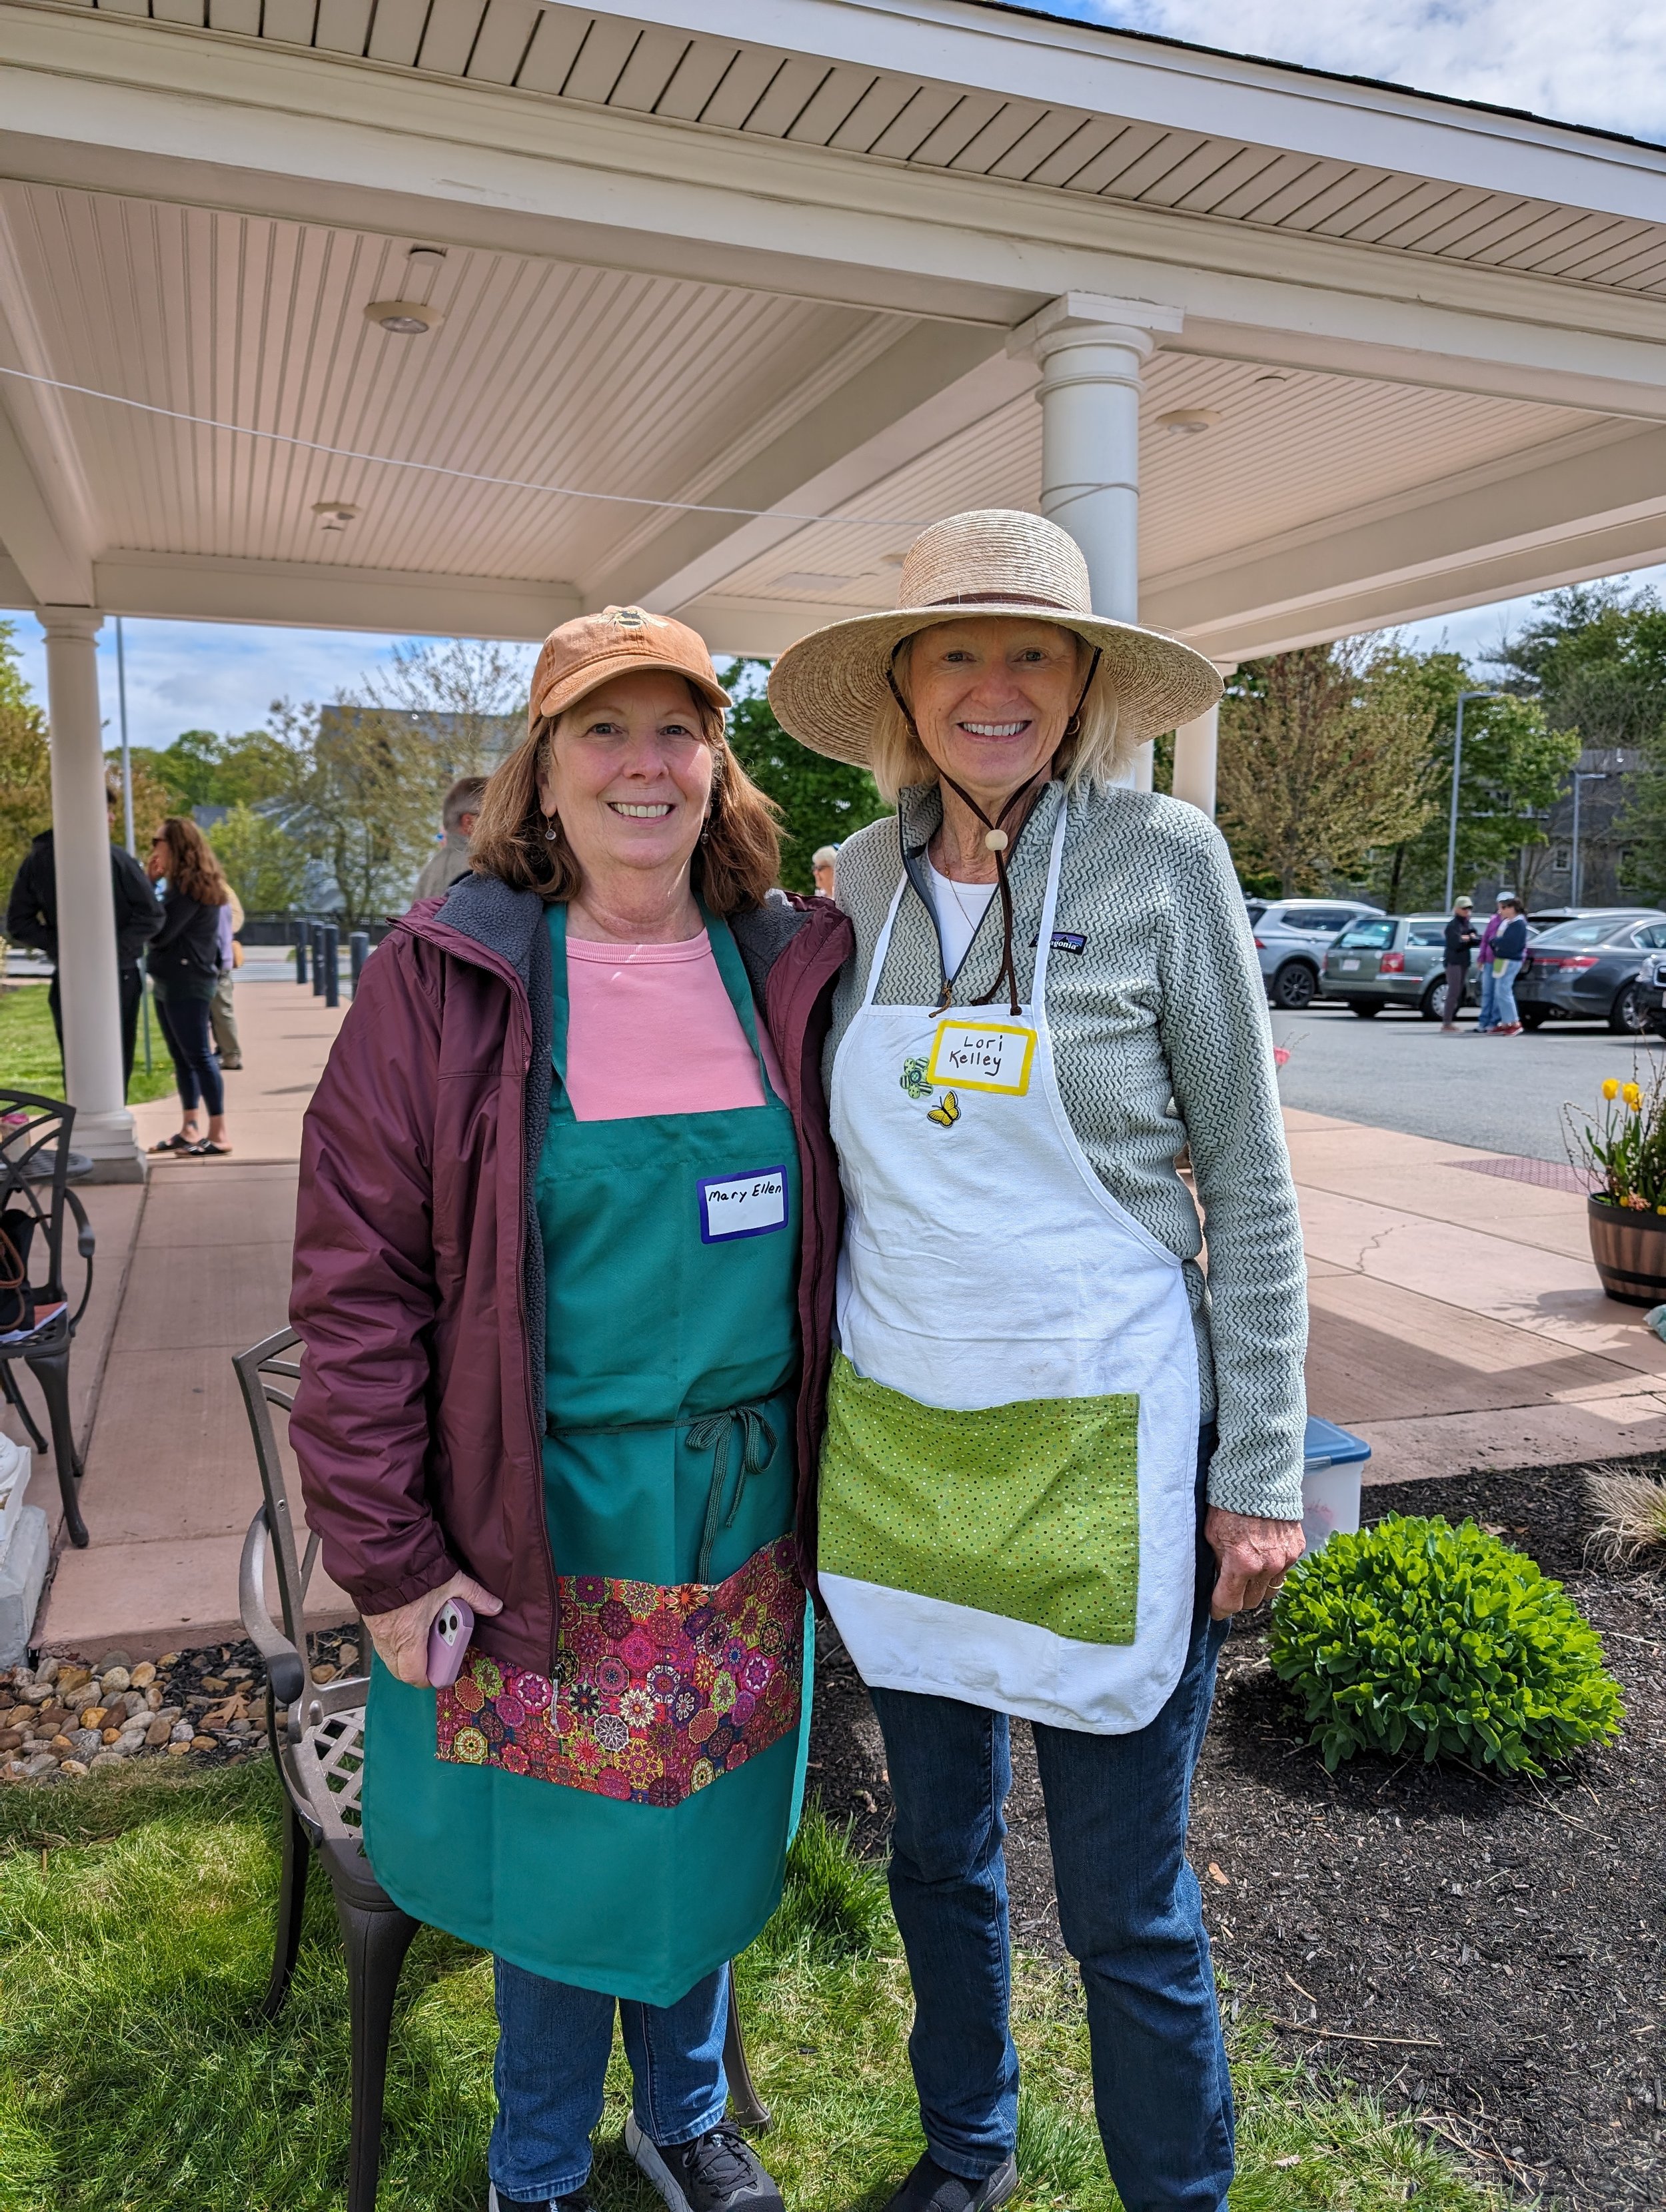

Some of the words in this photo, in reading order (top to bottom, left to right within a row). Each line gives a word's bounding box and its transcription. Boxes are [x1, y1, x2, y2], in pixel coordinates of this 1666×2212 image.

[964, 1035, 1003, 1051] Lori
[949, 1049, 1002, 1077] Kelley
[708, 1191, 747, 1203] Mary
[752, 1181, 782, 1197] Ellen
